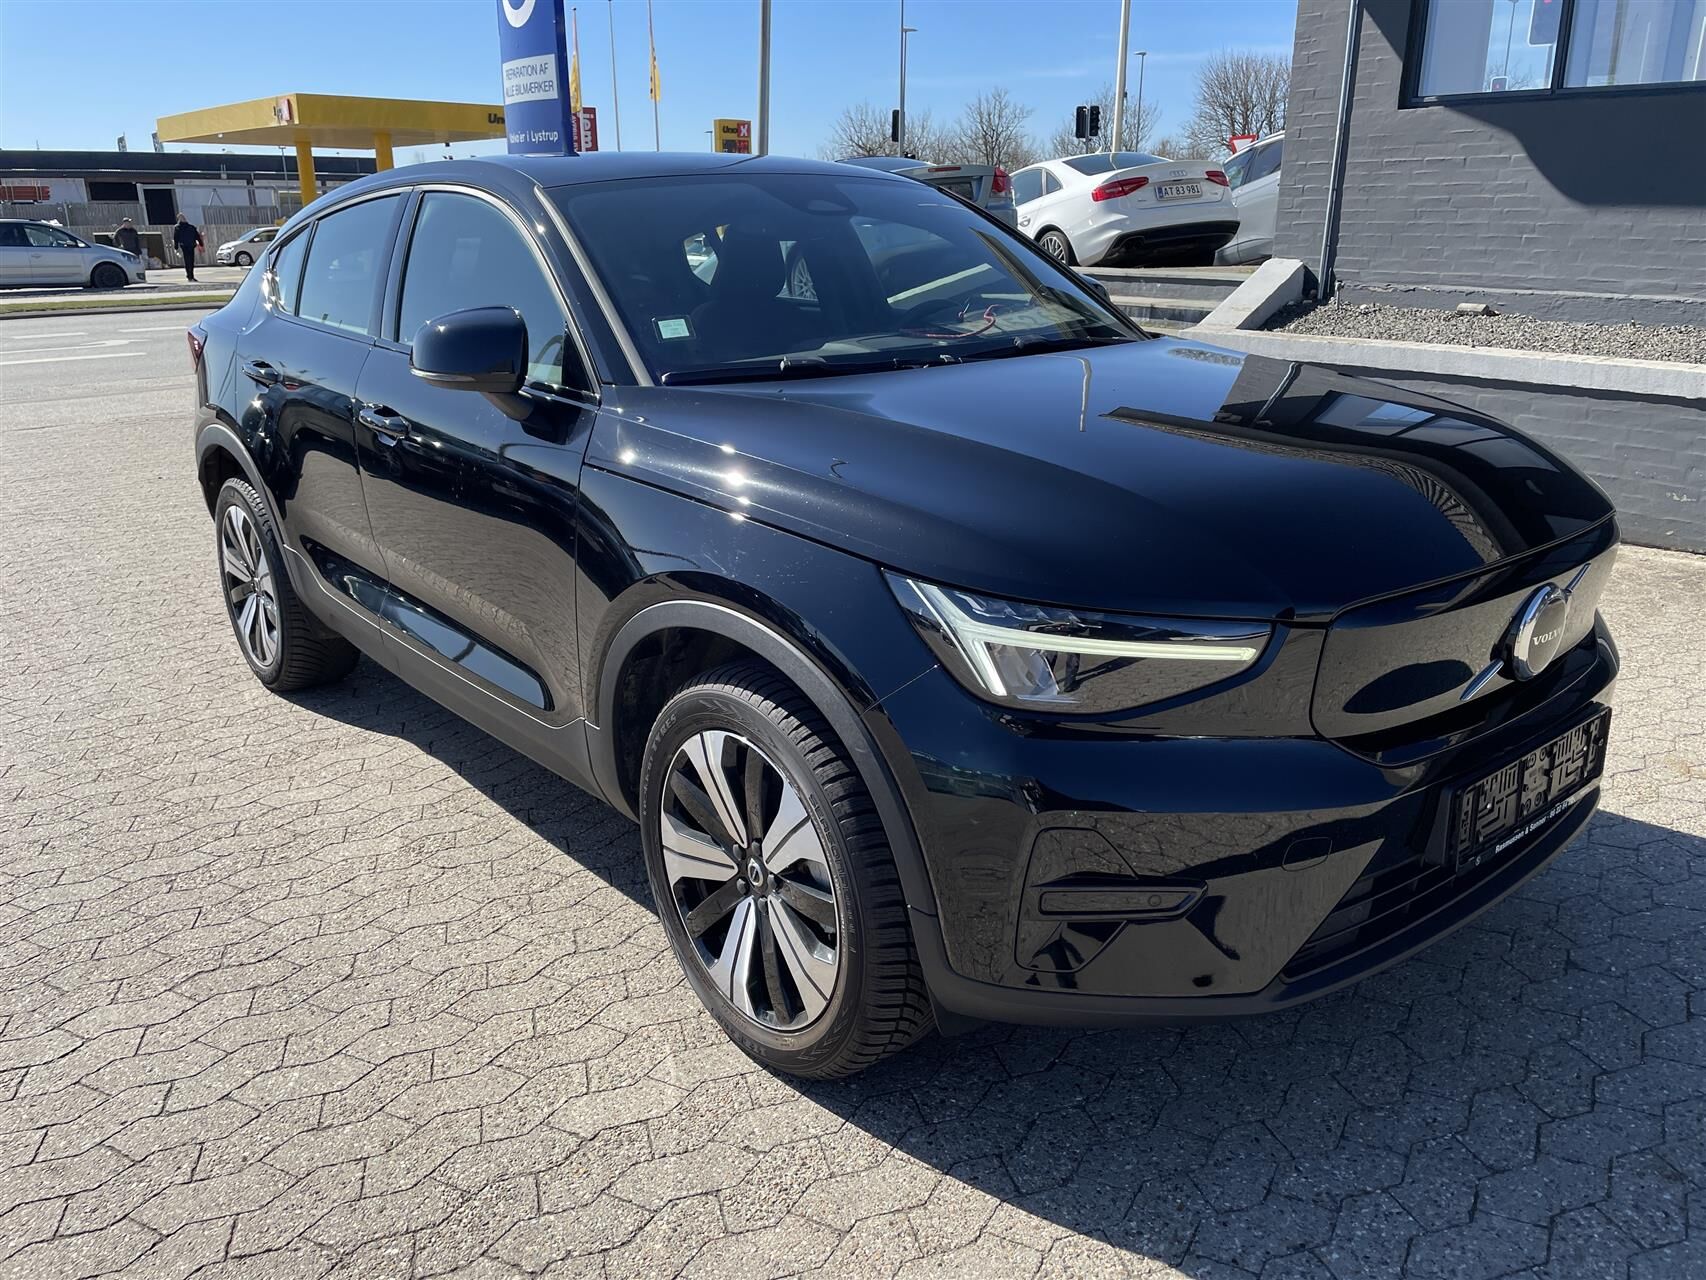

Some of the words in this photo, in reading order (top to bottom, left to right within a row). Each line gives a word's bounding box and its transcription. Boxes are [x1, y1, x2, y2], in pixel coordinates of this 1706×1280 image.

[539, 62, 549, 75] AF
[531, 130, 559, 144] Lystrup
[1164, 187, 1174, 196] AT
[1176, 186, 1186, 195] 83
[1187, 185, 1200, 194] 981
